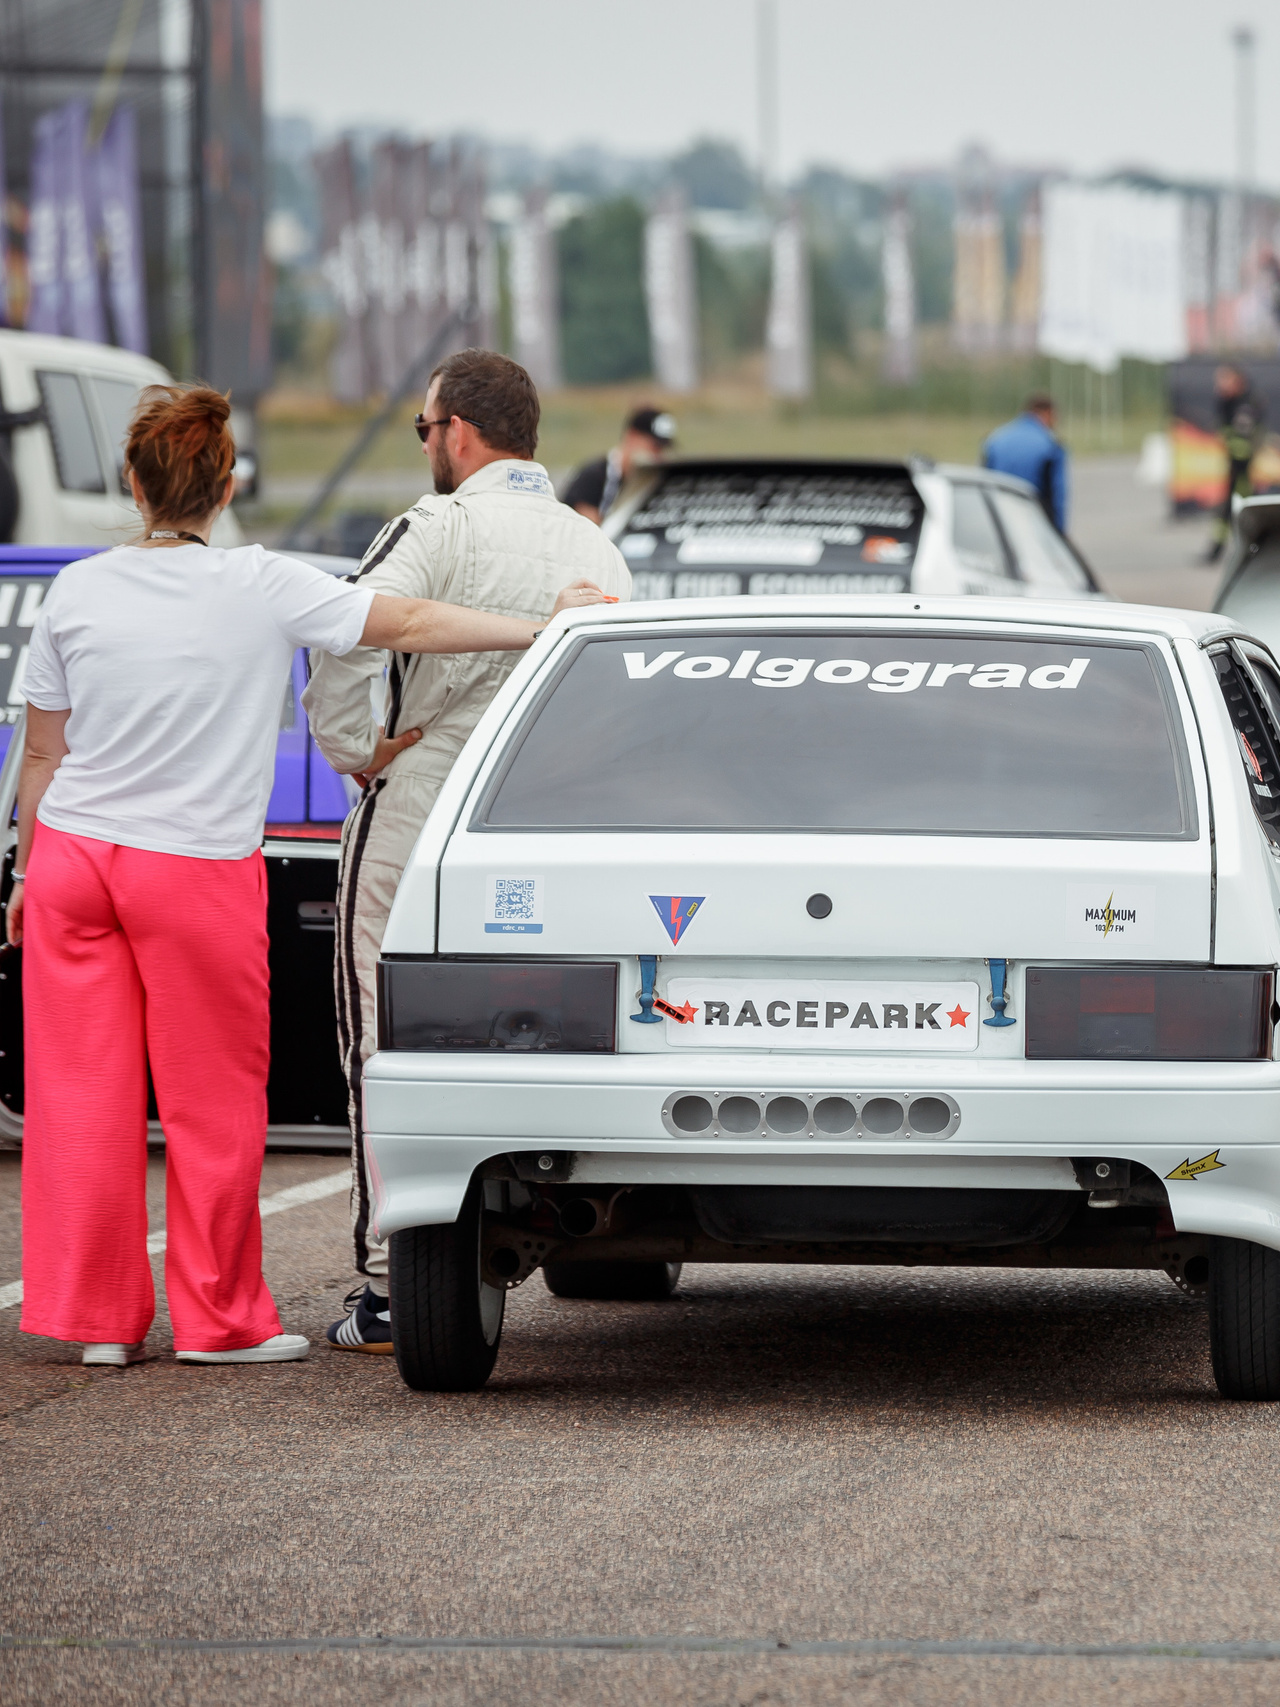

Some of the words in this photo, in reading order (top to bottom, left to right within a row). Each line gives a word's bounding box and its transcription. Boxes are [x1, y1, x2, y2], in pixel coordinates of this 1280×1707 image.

[622, 650, 1091, 694] Volgograd
[1085, 908, 1136, 923] MAXIMUM
[502, 924, 525, 932] rdrc_ru
[1115, 925, 1125, 933] FM
[703, 1000, 943, 1030] RACEPARK
[1180, 1162, 1207, 1176] ShonX
